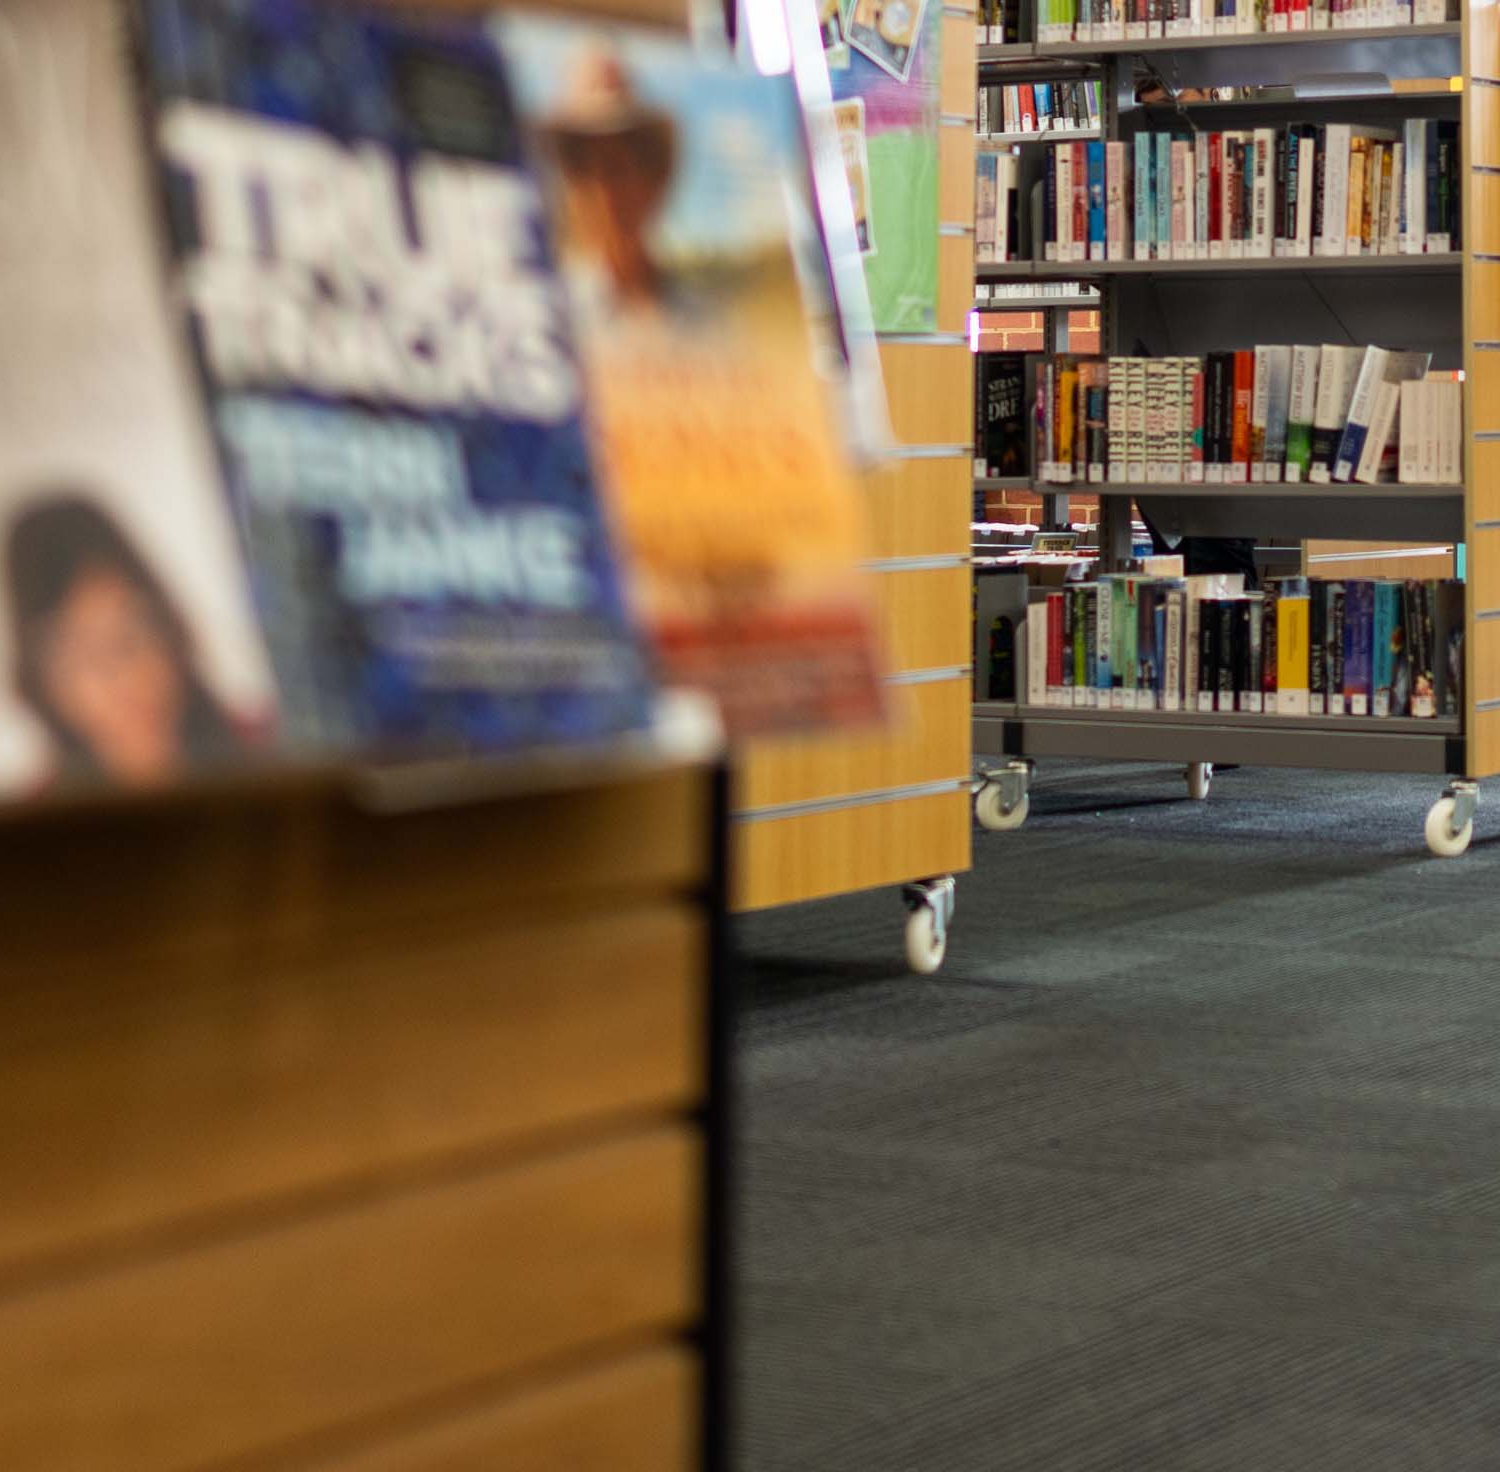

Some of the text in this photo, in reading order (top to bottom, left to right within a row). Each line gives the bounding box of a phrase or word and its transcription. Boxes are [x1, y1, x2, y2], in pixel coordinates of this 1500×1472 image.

[160, 100, 544, 280] TRUE
[184, 263, 579, 422] TRACKS
[1110, 361, 1124, 408] KILEY
[1127, 361, 1143, 464] KILEY REI
[1110, 430, 1124, 464] REI
[1165, 430, 1180, 464] REI
